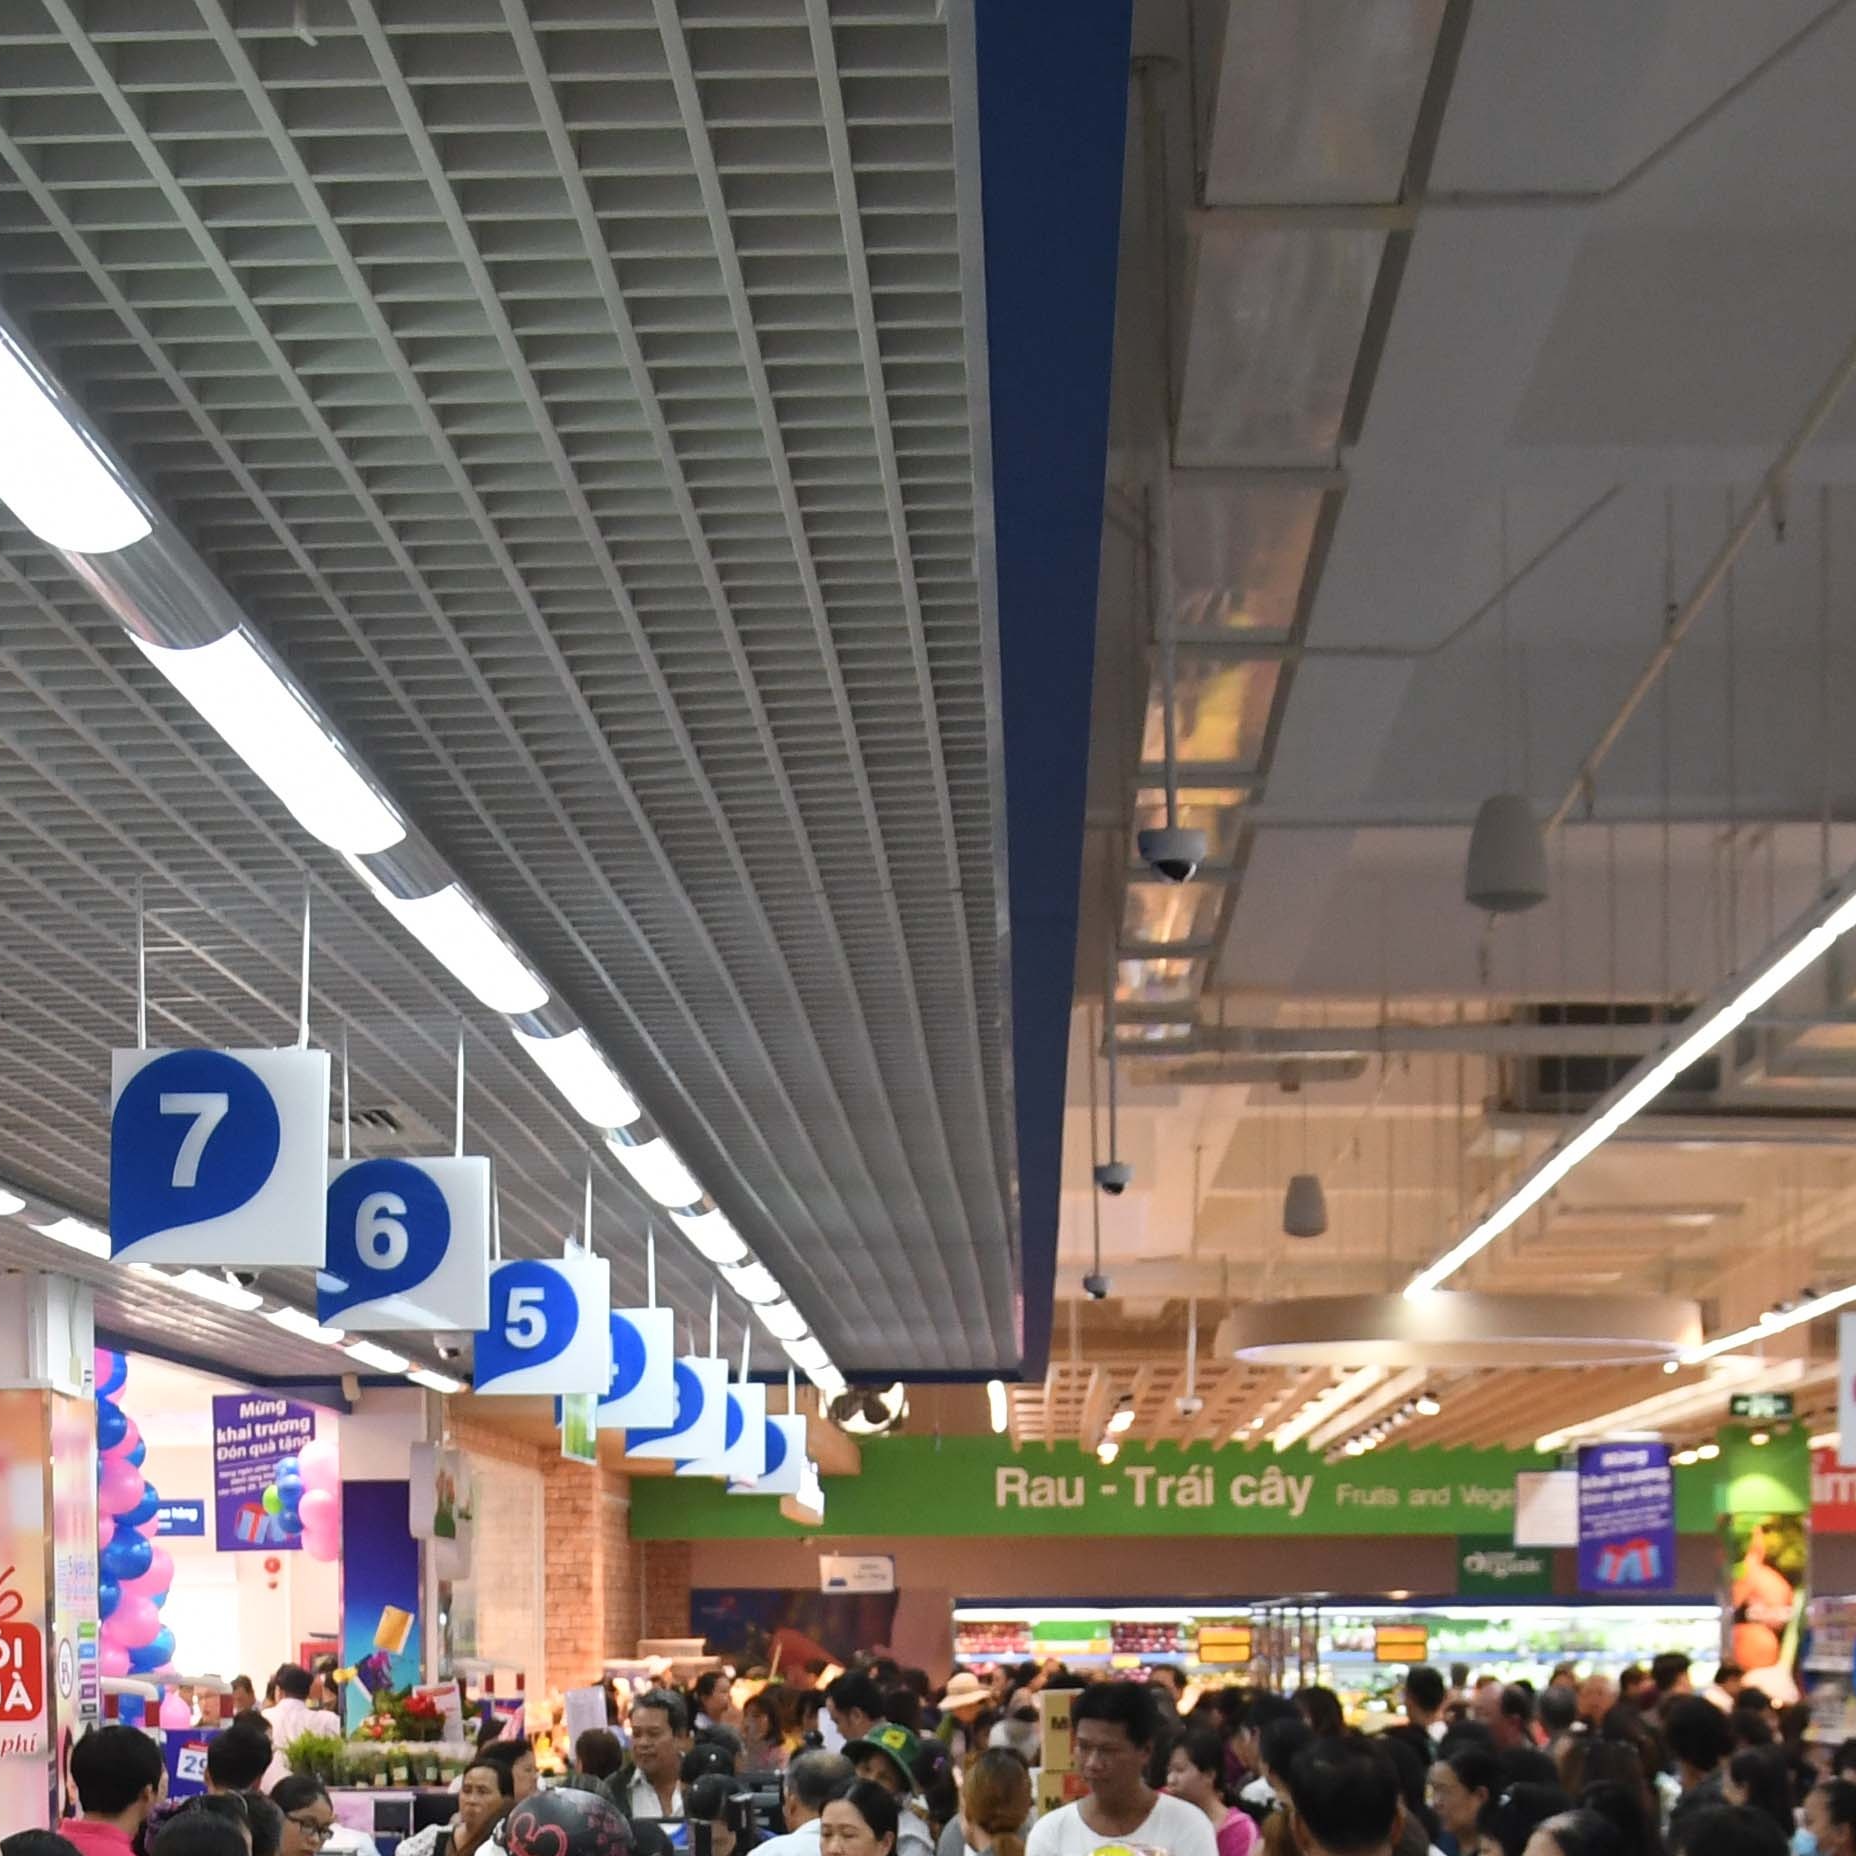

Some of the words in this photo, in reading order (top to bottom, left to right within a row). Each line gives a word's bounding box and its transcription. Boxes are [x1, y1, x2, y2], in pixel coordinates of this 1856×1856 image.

[160, 1093, 228, 1188] 7
[355, 1192, 408, 1270] 6
[504, 1287, 547, 1349] 5
[239, 1400, 287, 1419] Mừng
[216, 1426, 252, 1444] khai
[255, 1416, 311, 1437] trương
[216, 1445, 247, 1462] Đón
[996, 1467, 1084, 1507] Rau
[1123, 1466, 1214, 1507] Trái
[1230, 1464, 1313, 1517] cây
[1336, 1483, 1400, 1507] Fruits
[1408, 1483, 1451, 1506] and
[1460, 1483, 1516, 1511] Vege
[0, 1732, 38, 1759] phí
